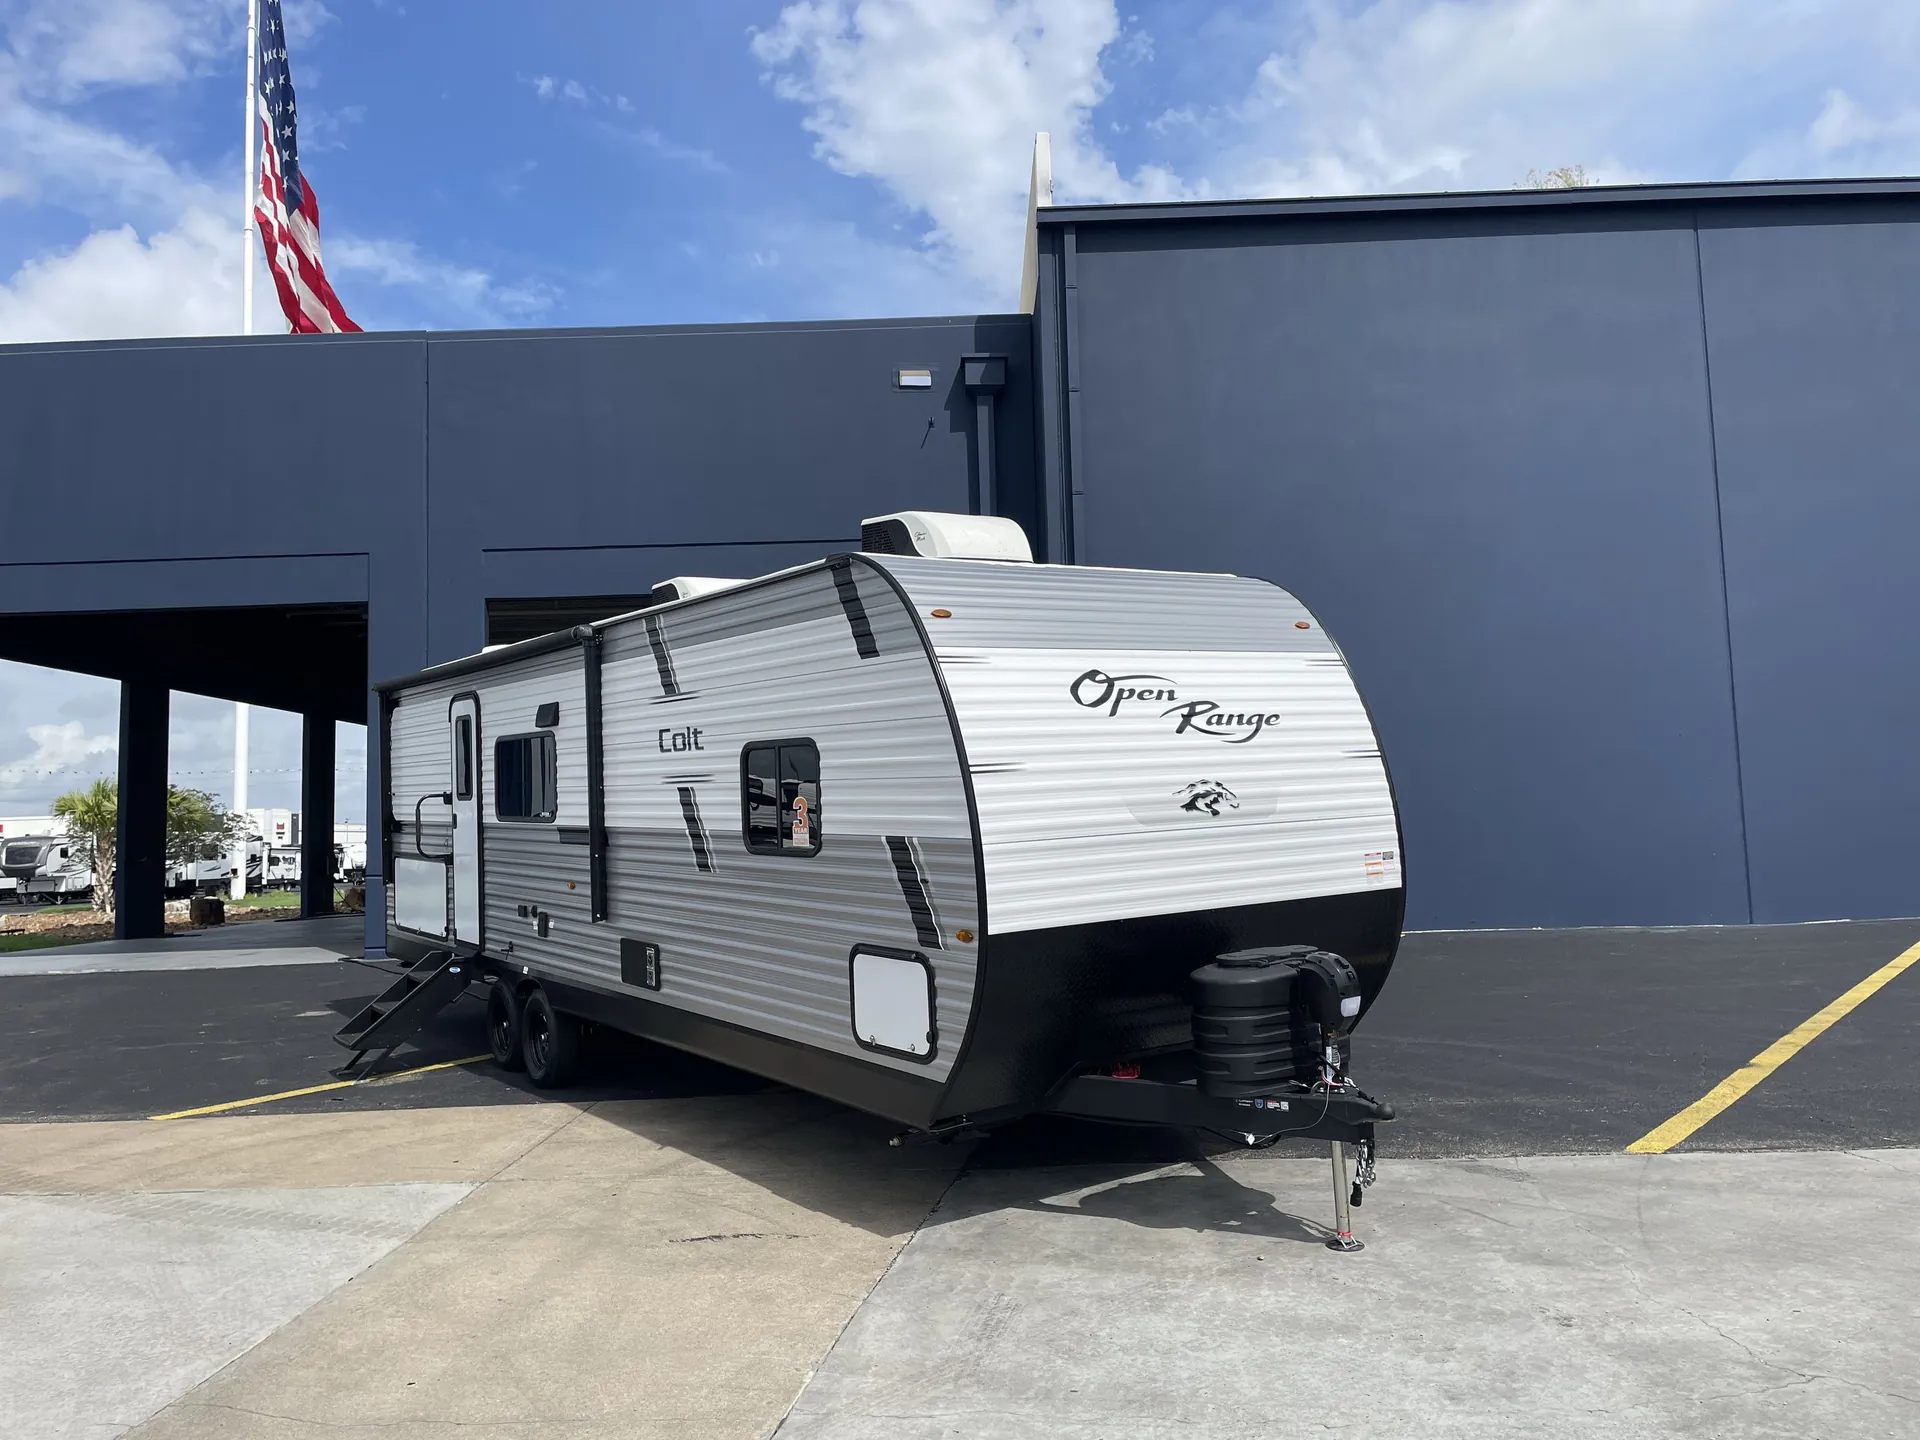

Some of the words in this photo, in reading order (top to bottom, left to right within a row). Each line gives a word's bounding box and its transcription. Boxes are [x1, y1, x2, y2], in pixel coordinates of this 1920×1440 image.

[1070, 669, 1179, 717] Open
[658, 726, 704, 753] Colt
[1159, 700, 1281, 743] Range
[793, 796, 809, 828] 3
